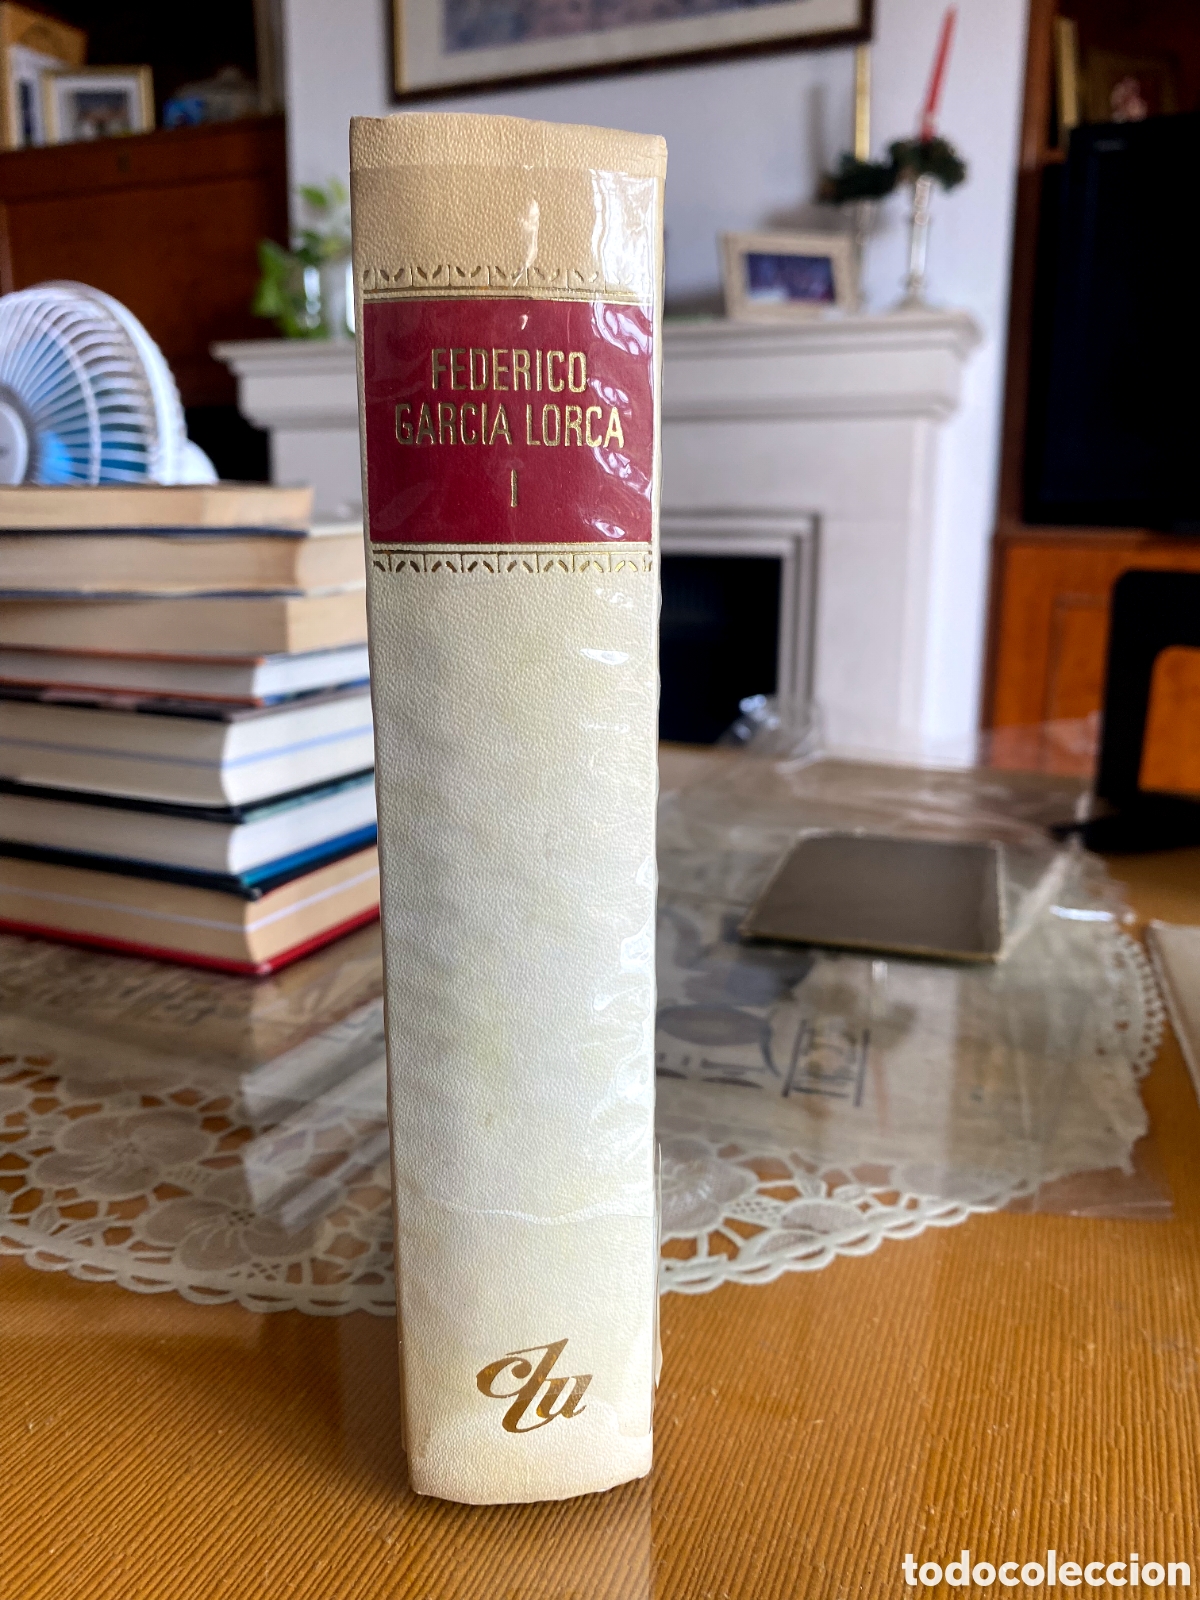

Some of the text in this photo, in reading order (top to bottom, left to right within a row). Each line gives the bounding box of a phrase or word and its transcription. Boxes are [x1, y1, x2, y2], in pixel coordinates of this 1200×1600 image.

[431, 347, 588, 394] FEDERICO
[394, 402, 625, 449] GARCIA LORCA
[509, 468, 519, 509] I
